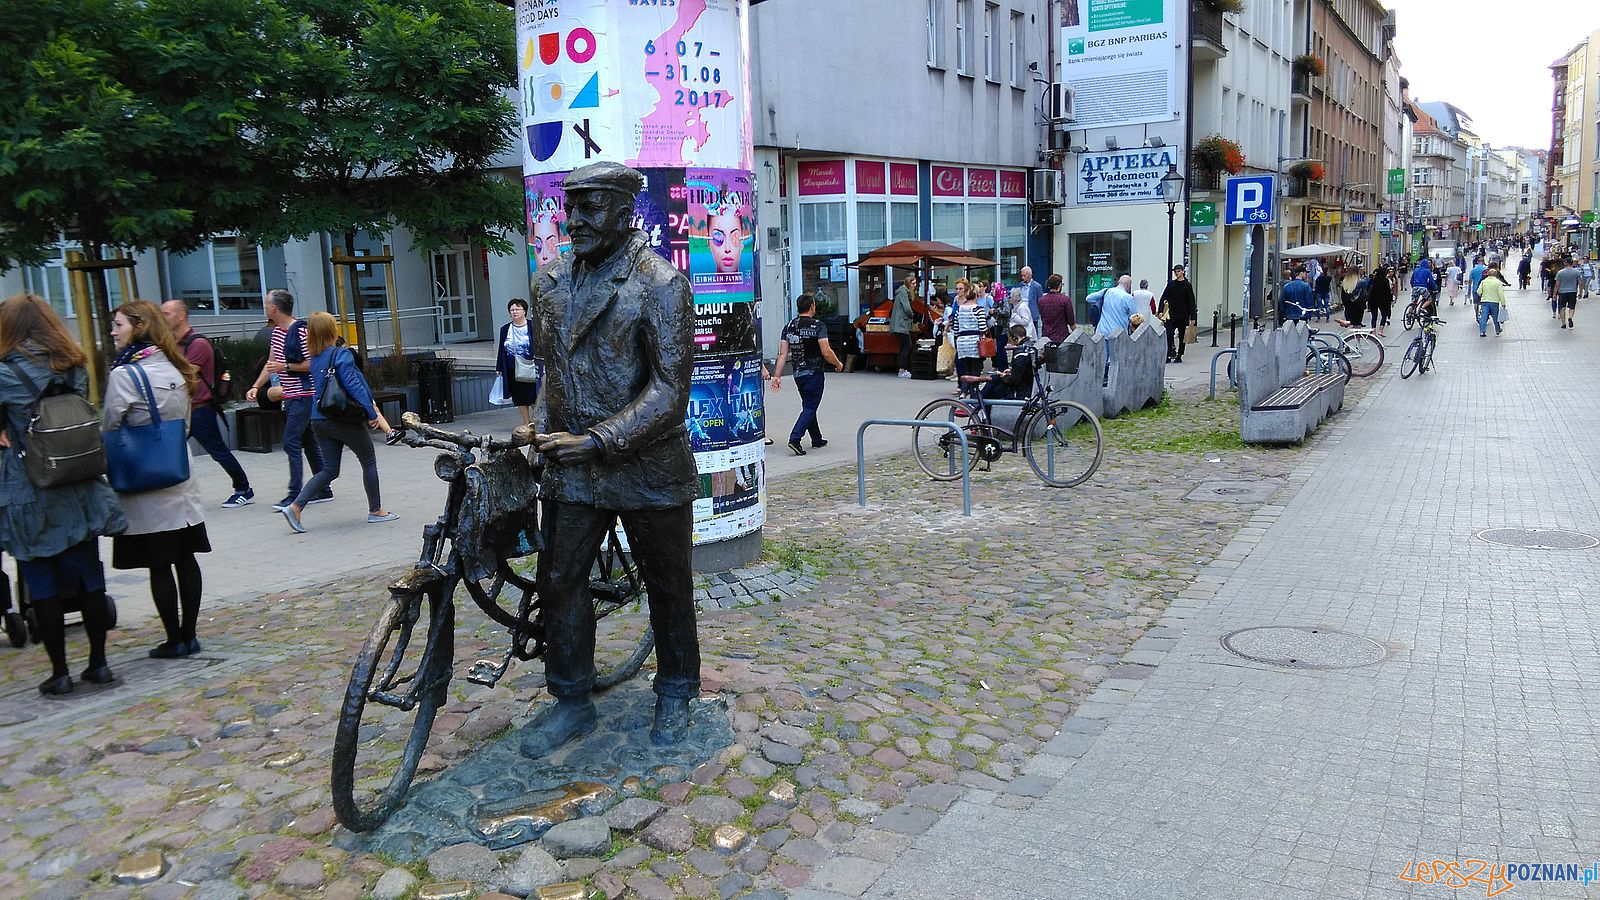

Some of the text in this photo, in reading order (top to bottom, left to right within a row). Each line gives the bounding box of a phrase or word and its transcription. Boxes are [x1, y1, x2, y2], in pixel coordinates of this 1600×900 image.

[538, 7, 559, 21] DAYS
[1108, 36, 1127, 46] BNP
[1129, 31, 1168, 43] PARIBAS
[1126, 50, 1143, 58] świata
[675, 89, 722, 108] 2017
[1081, 151, 1172, 173] APTEKA
[808, 168, 834, 176] Marek
[1100, 171, 1160, 182] Vademecu
[936, 169, 1021, 194] Cukiernia
[1236, 182, 1263, 219] P
[702, 419, 724, 428] OPEN
